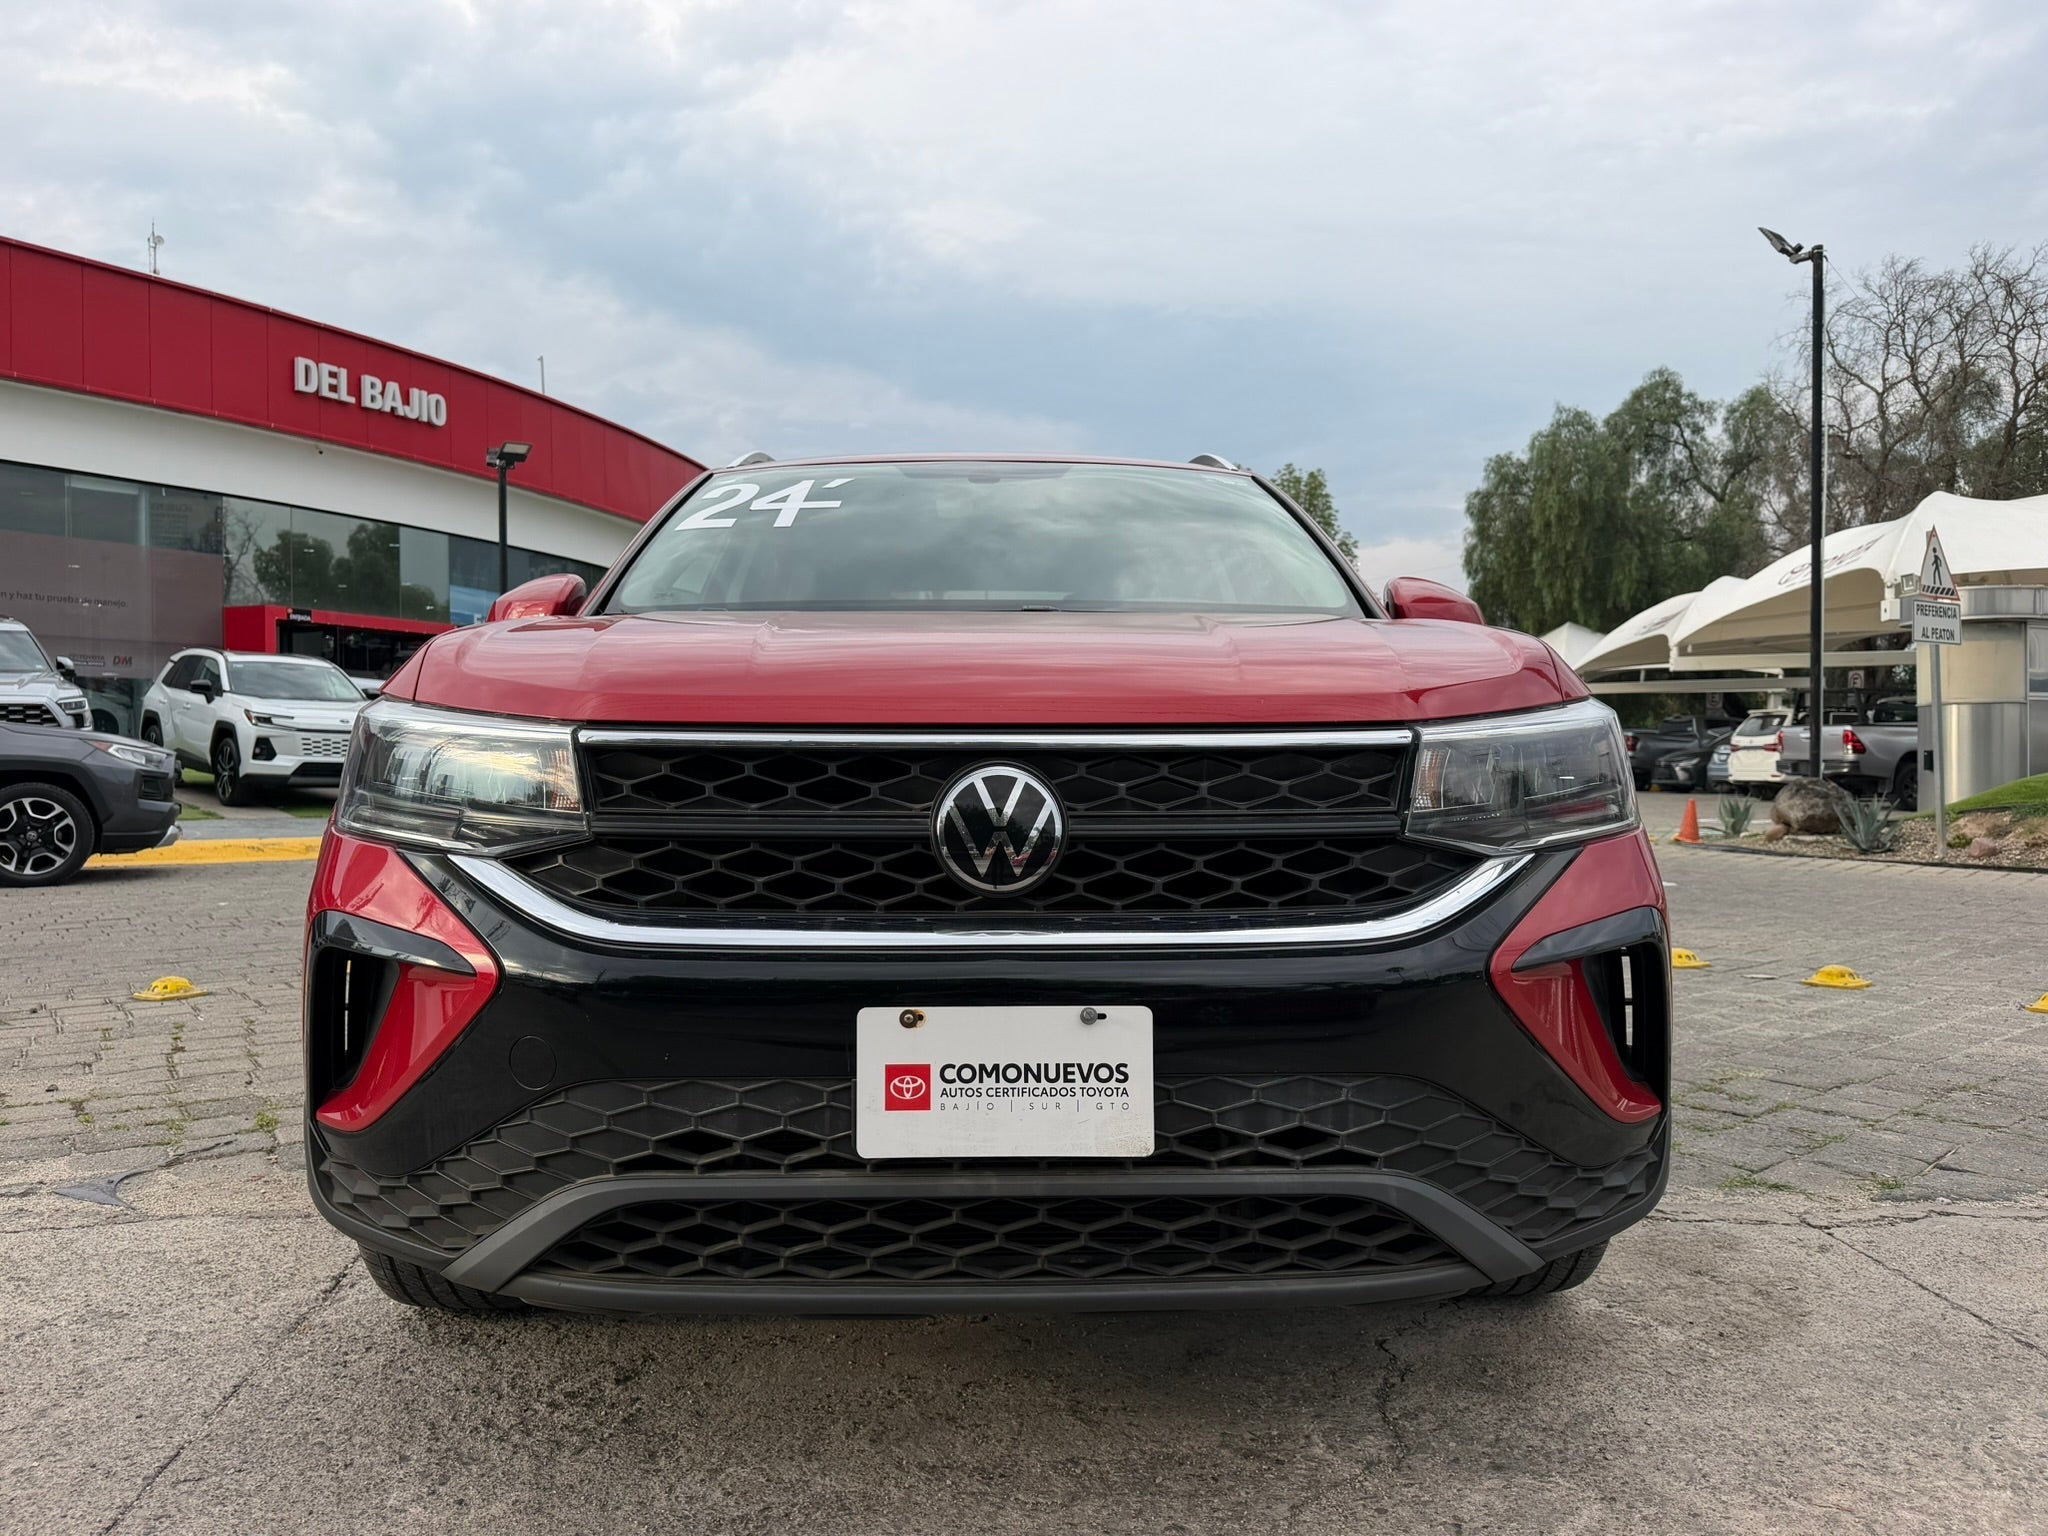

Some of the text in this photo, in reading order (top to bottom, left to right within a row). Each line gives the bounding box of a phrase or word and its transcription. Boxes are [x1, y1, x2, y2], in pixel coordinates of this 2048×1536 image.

[294, 356, 447, 427] DEL BAJIO
[35, 592, 45, 601] tu
[1916, 603, 1957, 620] PREFERENCIA
[1921, 626, 1955, 641] AL PEATON
[939, 1063, 1130, 1084] COMONUEVOS
[940, 1087, 1129, 1098] AUTOS CERTIFICADOS TOYOTA
[1029, 1102, 1061, 1111] SUR
[1096, 1102, 1130, 1111] GTO
